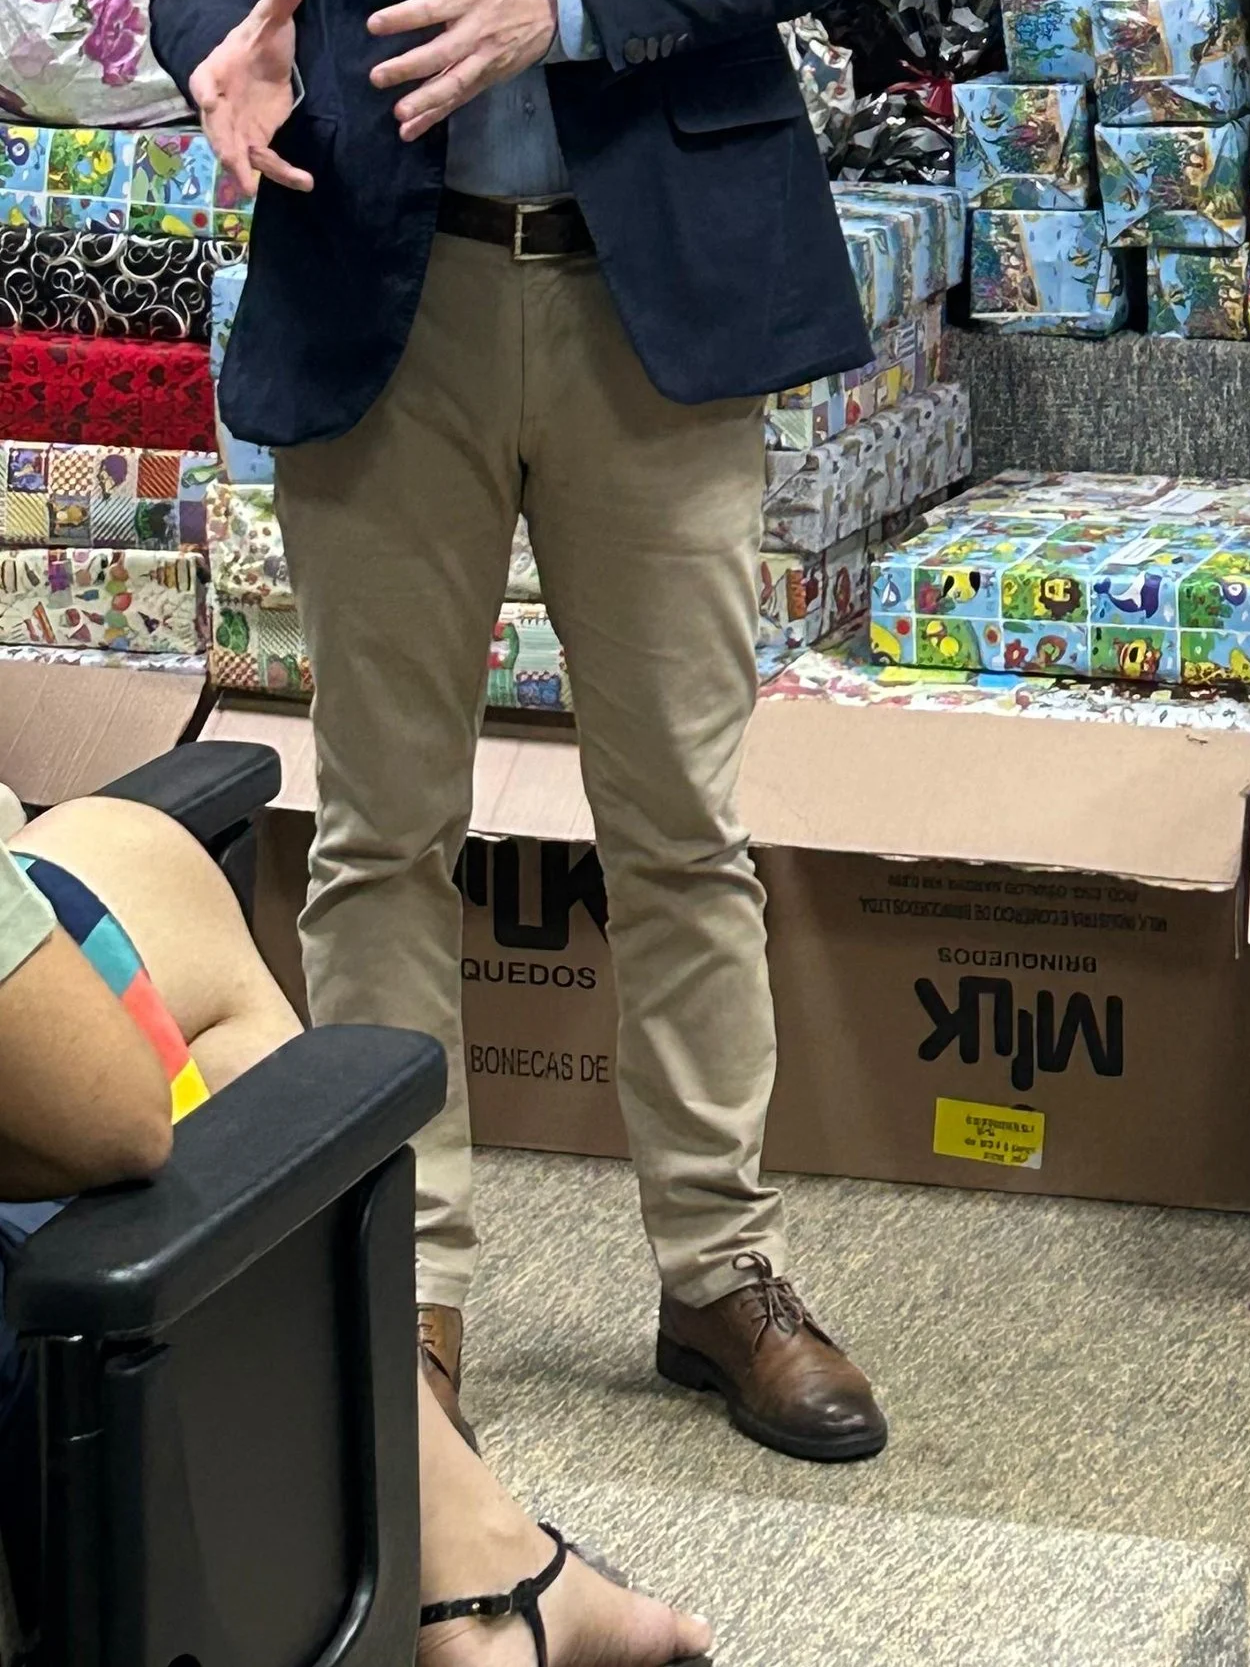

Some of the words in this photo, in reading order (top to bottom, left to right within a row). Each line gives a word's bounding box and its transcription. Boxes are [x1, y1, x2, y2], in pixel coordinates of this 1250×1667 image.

[461, 957, 598, 990] QUEDOS
[938, 945, 1097, 974] BRINQUEDOS
[470, 1044, 573, 1082] BONECAS
[580, 1054, 611, 1084] DE
